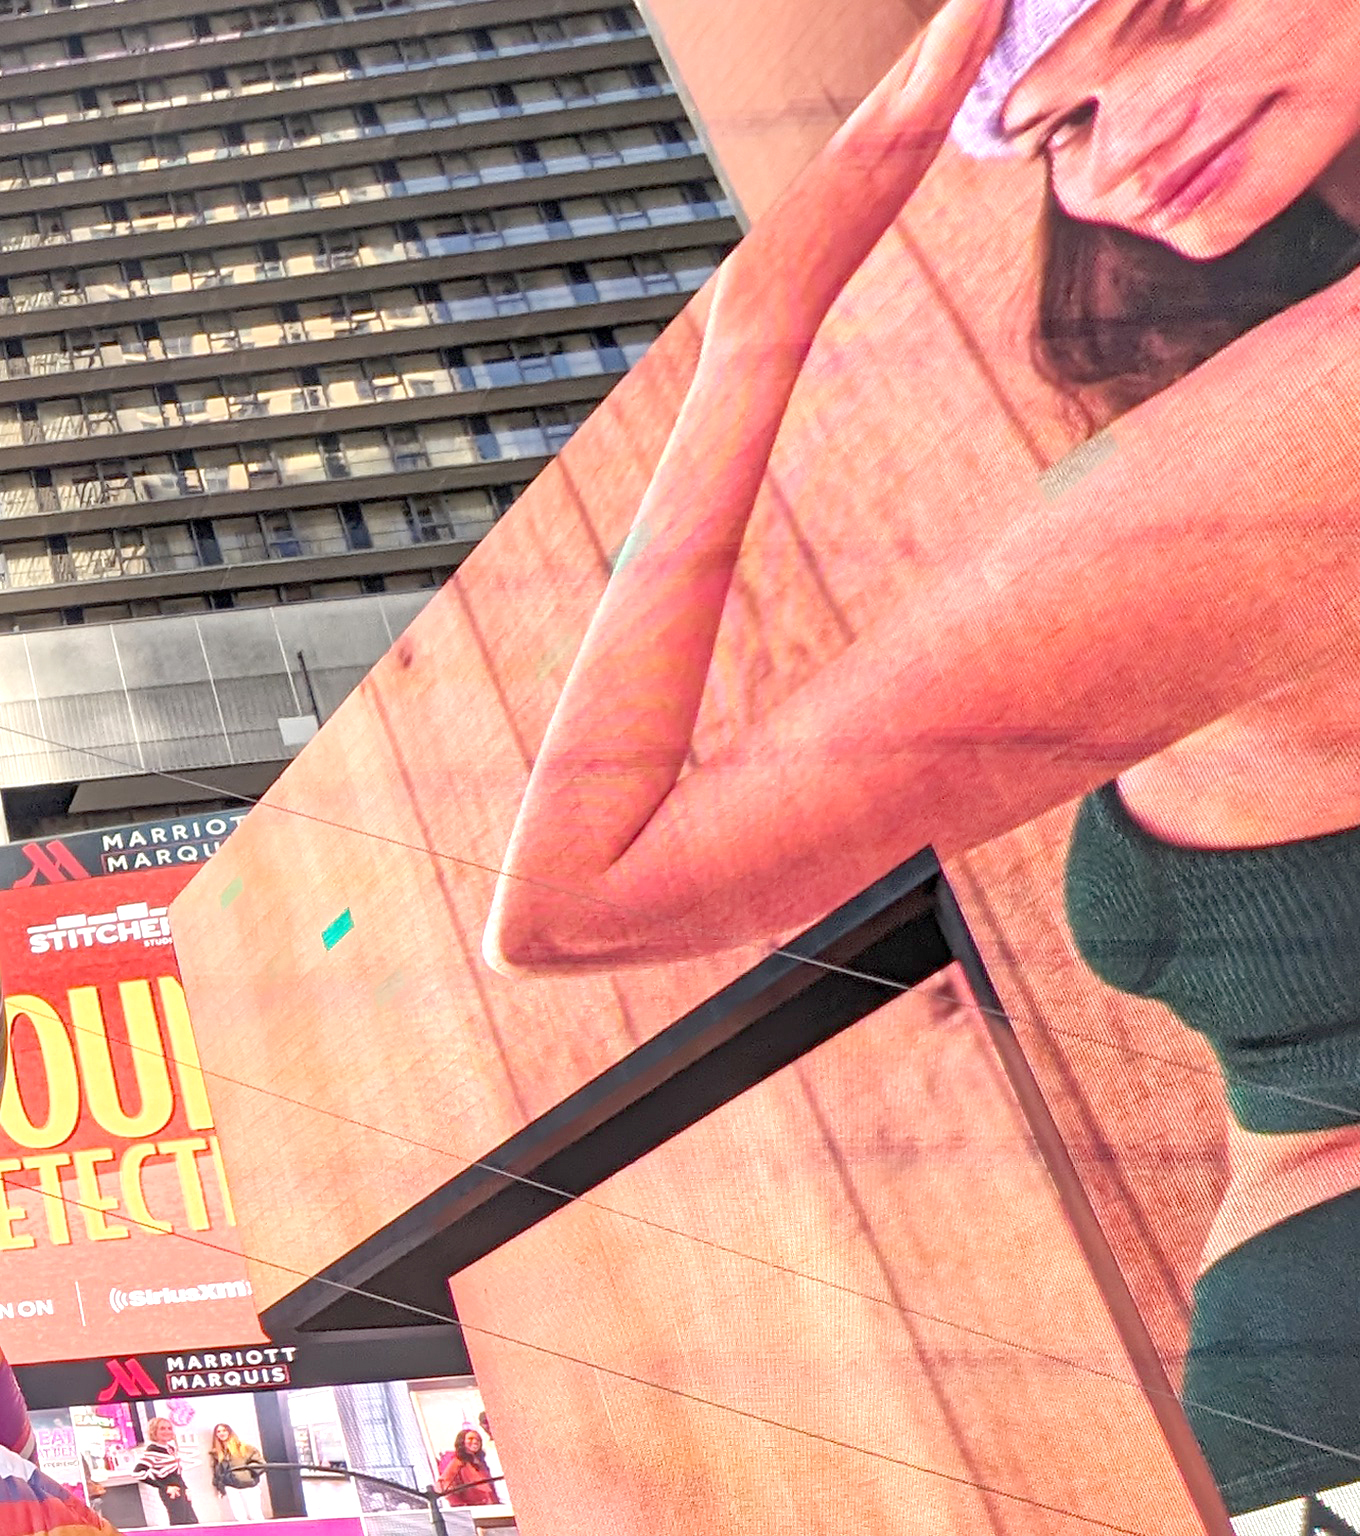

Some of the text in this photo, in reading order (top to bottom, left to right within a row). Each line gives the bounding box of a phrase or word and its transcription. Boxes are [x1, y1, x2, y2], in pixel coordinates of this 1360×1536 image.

[17, 1299, 55, 1318] ON
[166, 1346, 298, 1372] MARRIOTT
[169, 1365, 288, 1391] MARQUIS
